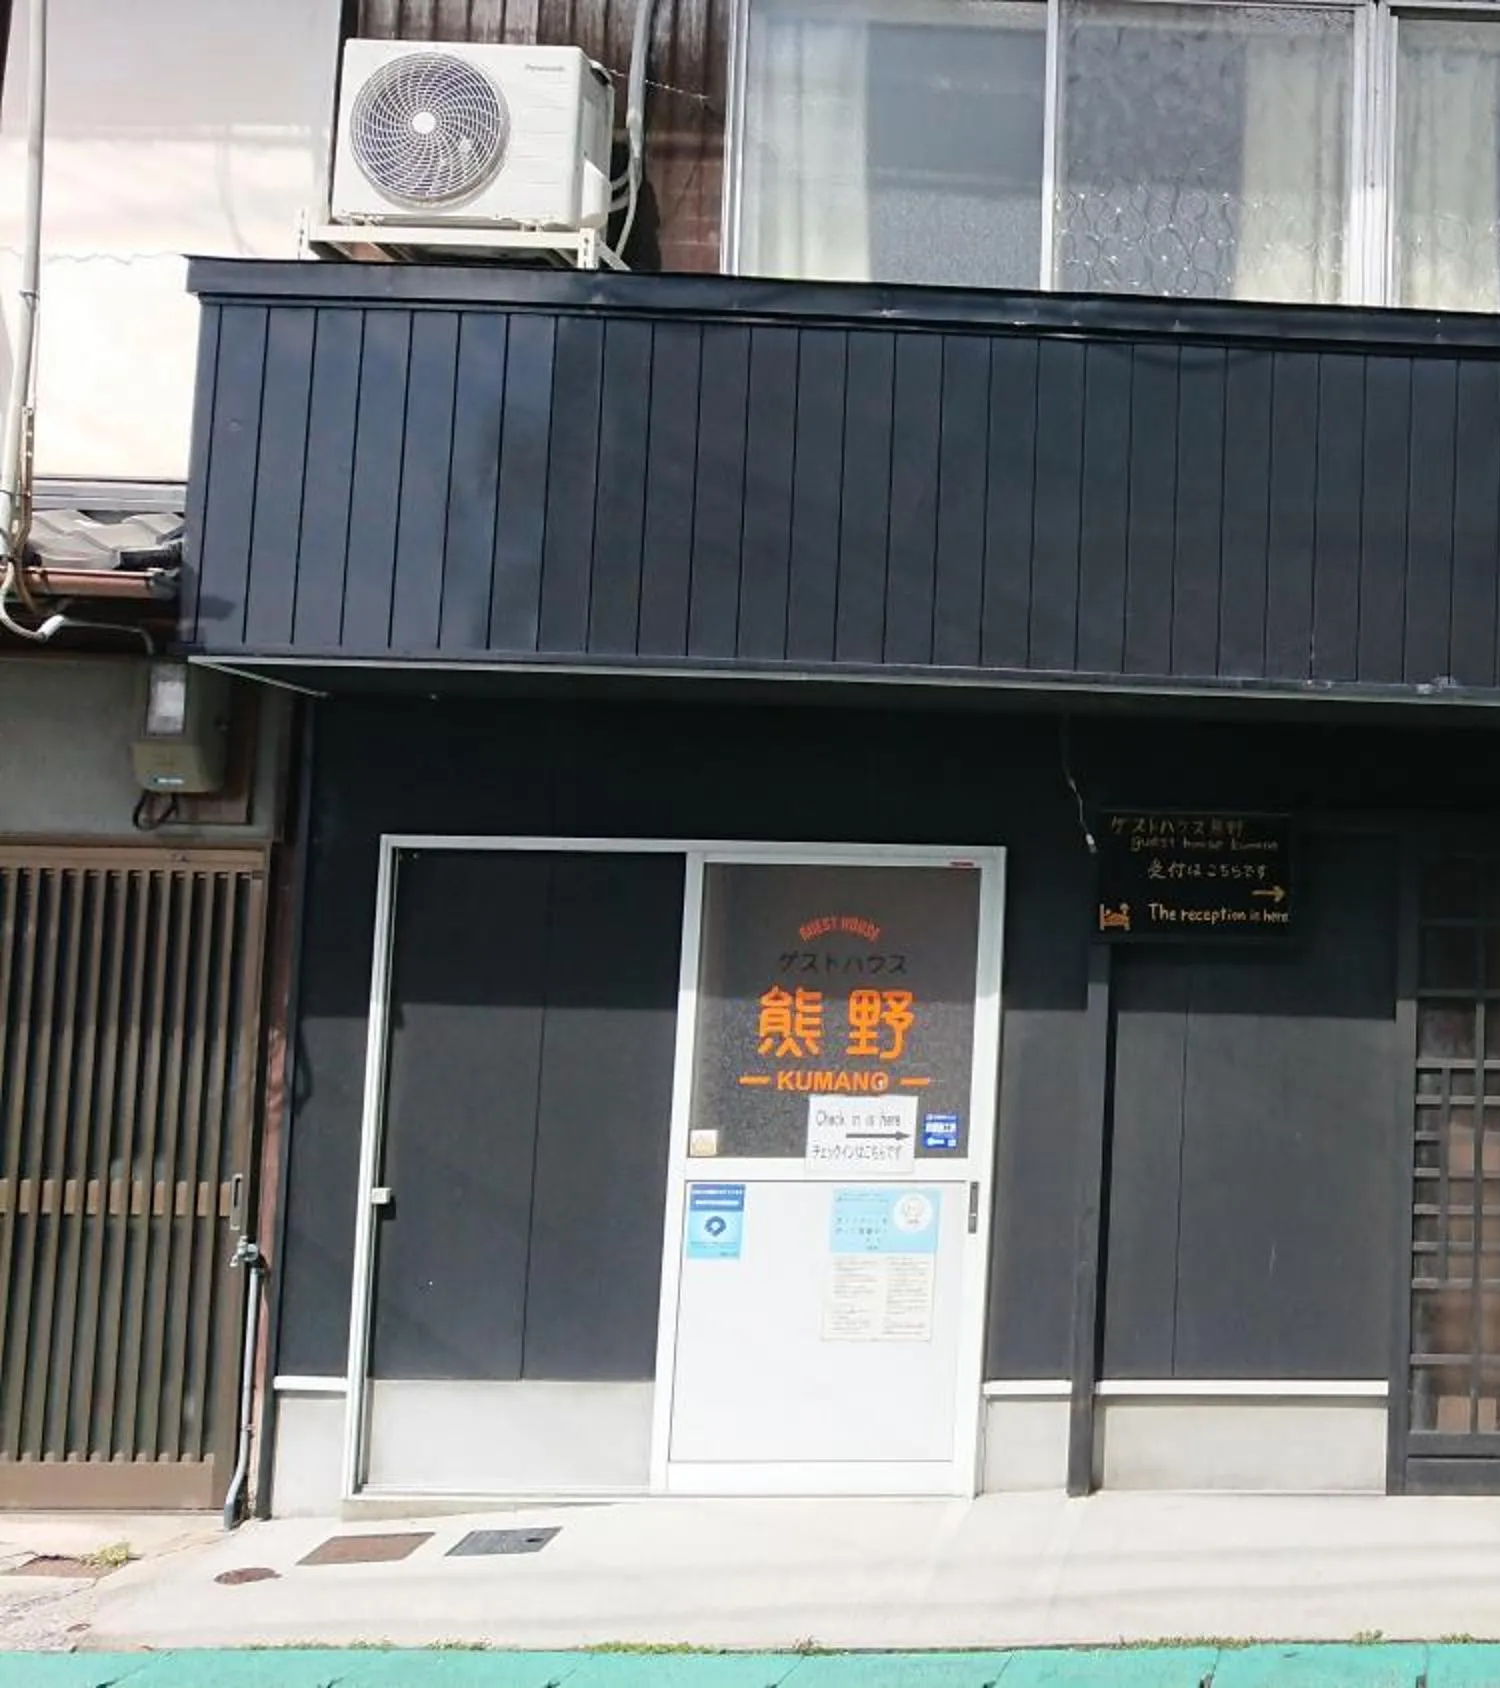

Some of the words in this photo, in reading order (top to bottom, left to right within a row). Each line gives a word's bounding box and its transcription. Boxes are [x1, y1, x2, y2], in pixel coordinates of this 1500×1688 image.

[1148, 858, 1268, 879] 受付はこちらです
[1148, 903, 1177, 921] The
[1181, 908, 1247, 925] reception
[779, 951, 909, 975] ゲストハウス
[757, 985, 918, 1060] 熊野
[777, 1071, 889, 1092] KUMANO
